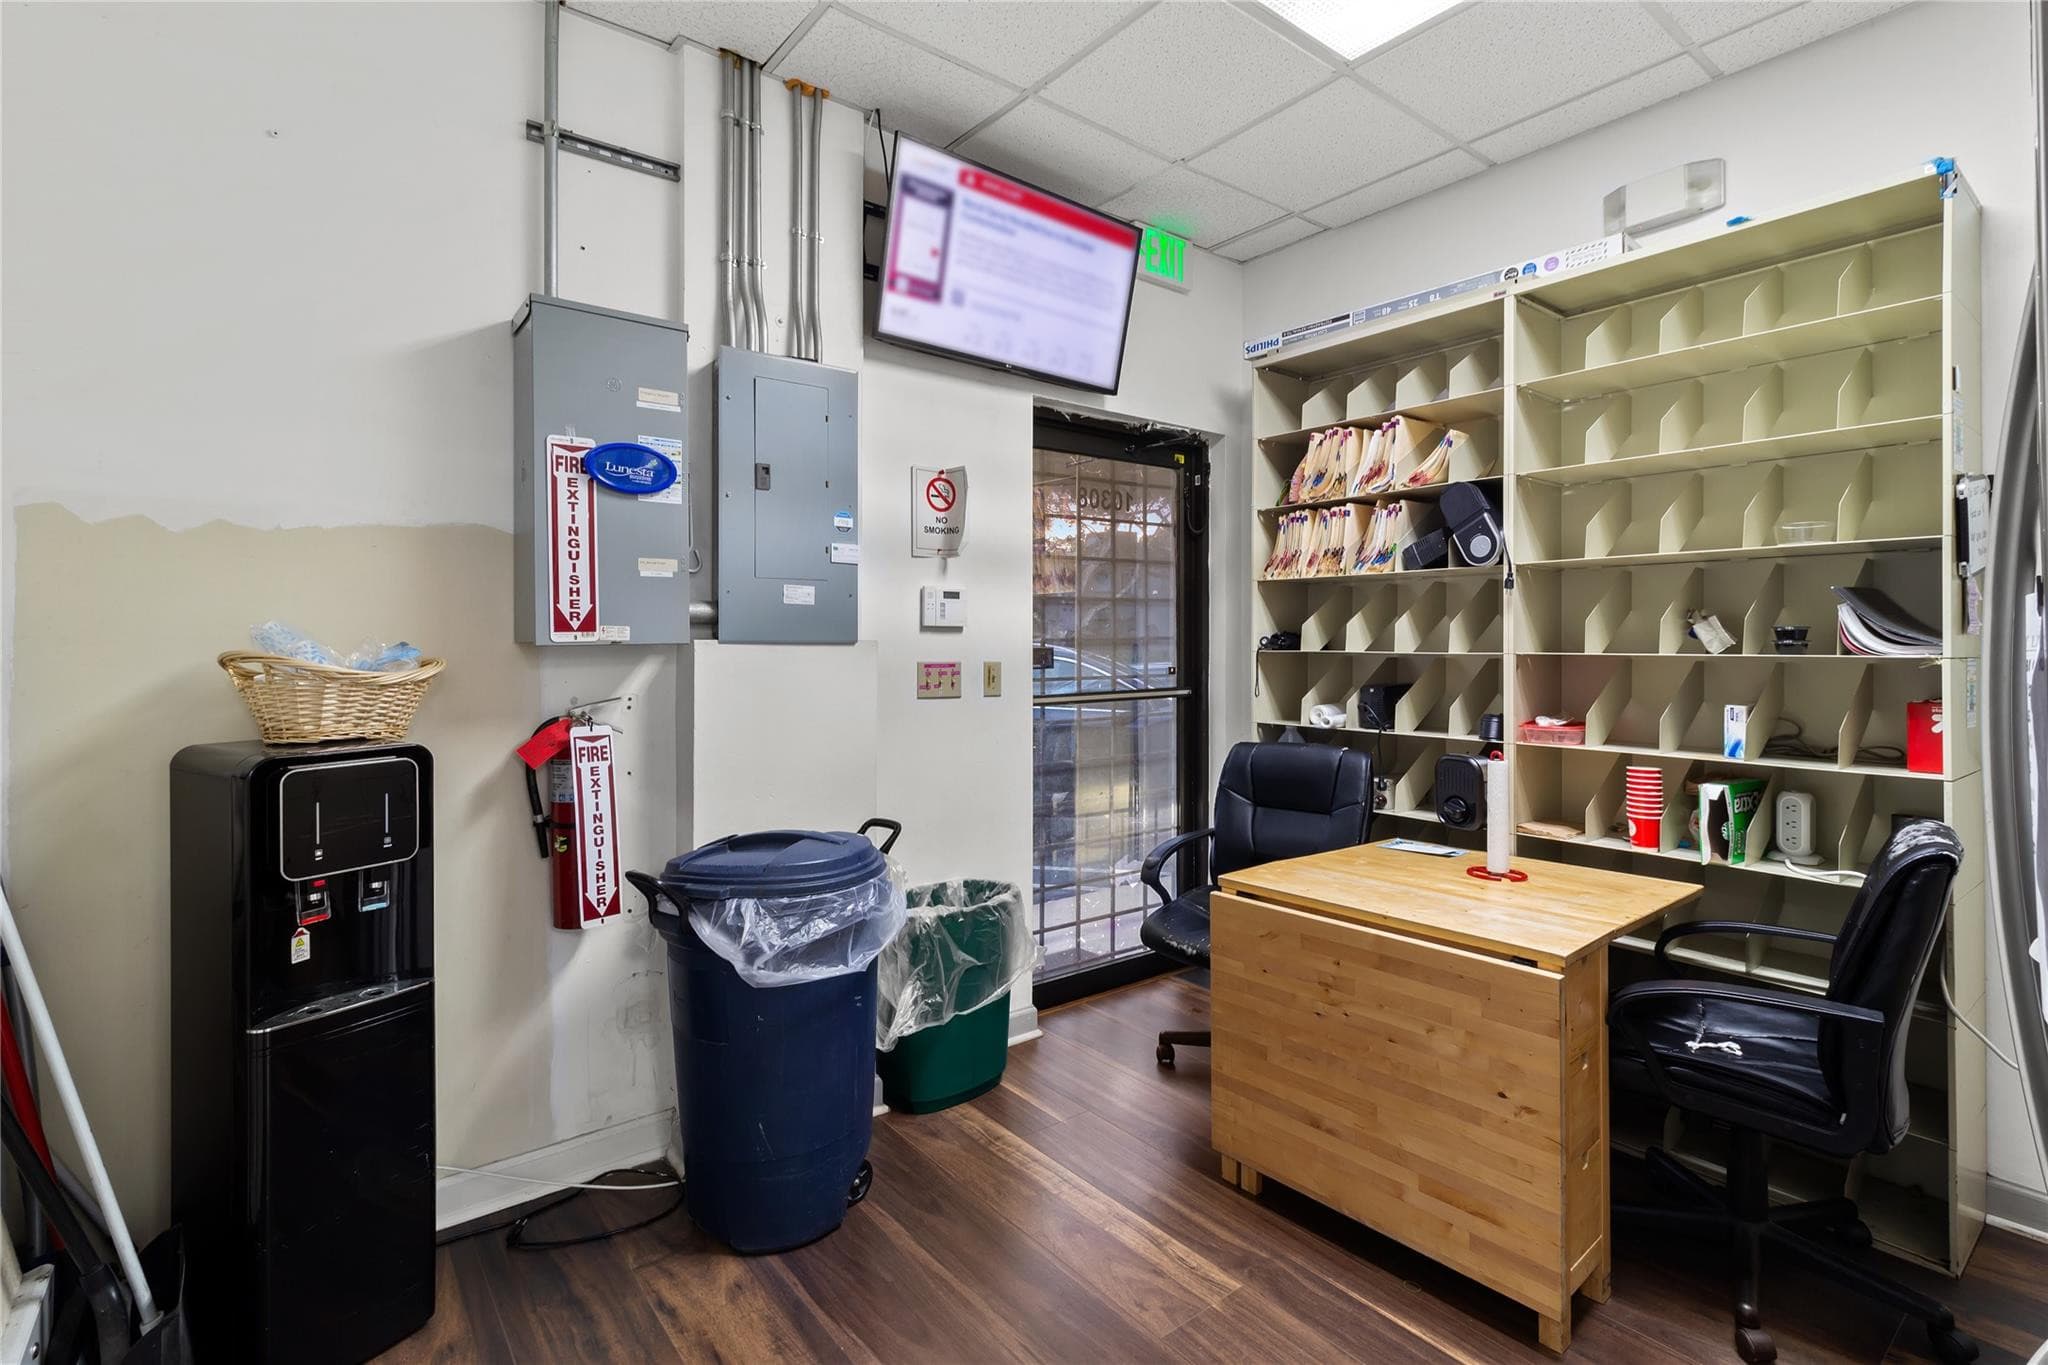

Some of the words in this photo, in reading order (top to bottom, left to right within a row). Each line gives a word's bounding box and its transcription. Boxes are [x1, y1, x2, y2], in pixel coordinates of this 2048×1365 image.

[1145, 227, 1186, 283] EXIT
[1245, 337, 1280, 354] PHILIPS
[605, 461, 655, 478] Lunesta
[935, 516, 948, 524] NO
[923, 525, 960, 535] SMOKING
[567, 477, 581, 621] EXTINGUISHER
[577, 745, 609, 764] FIRE
[589, 765, 607, 908] EXTINGUISHER
